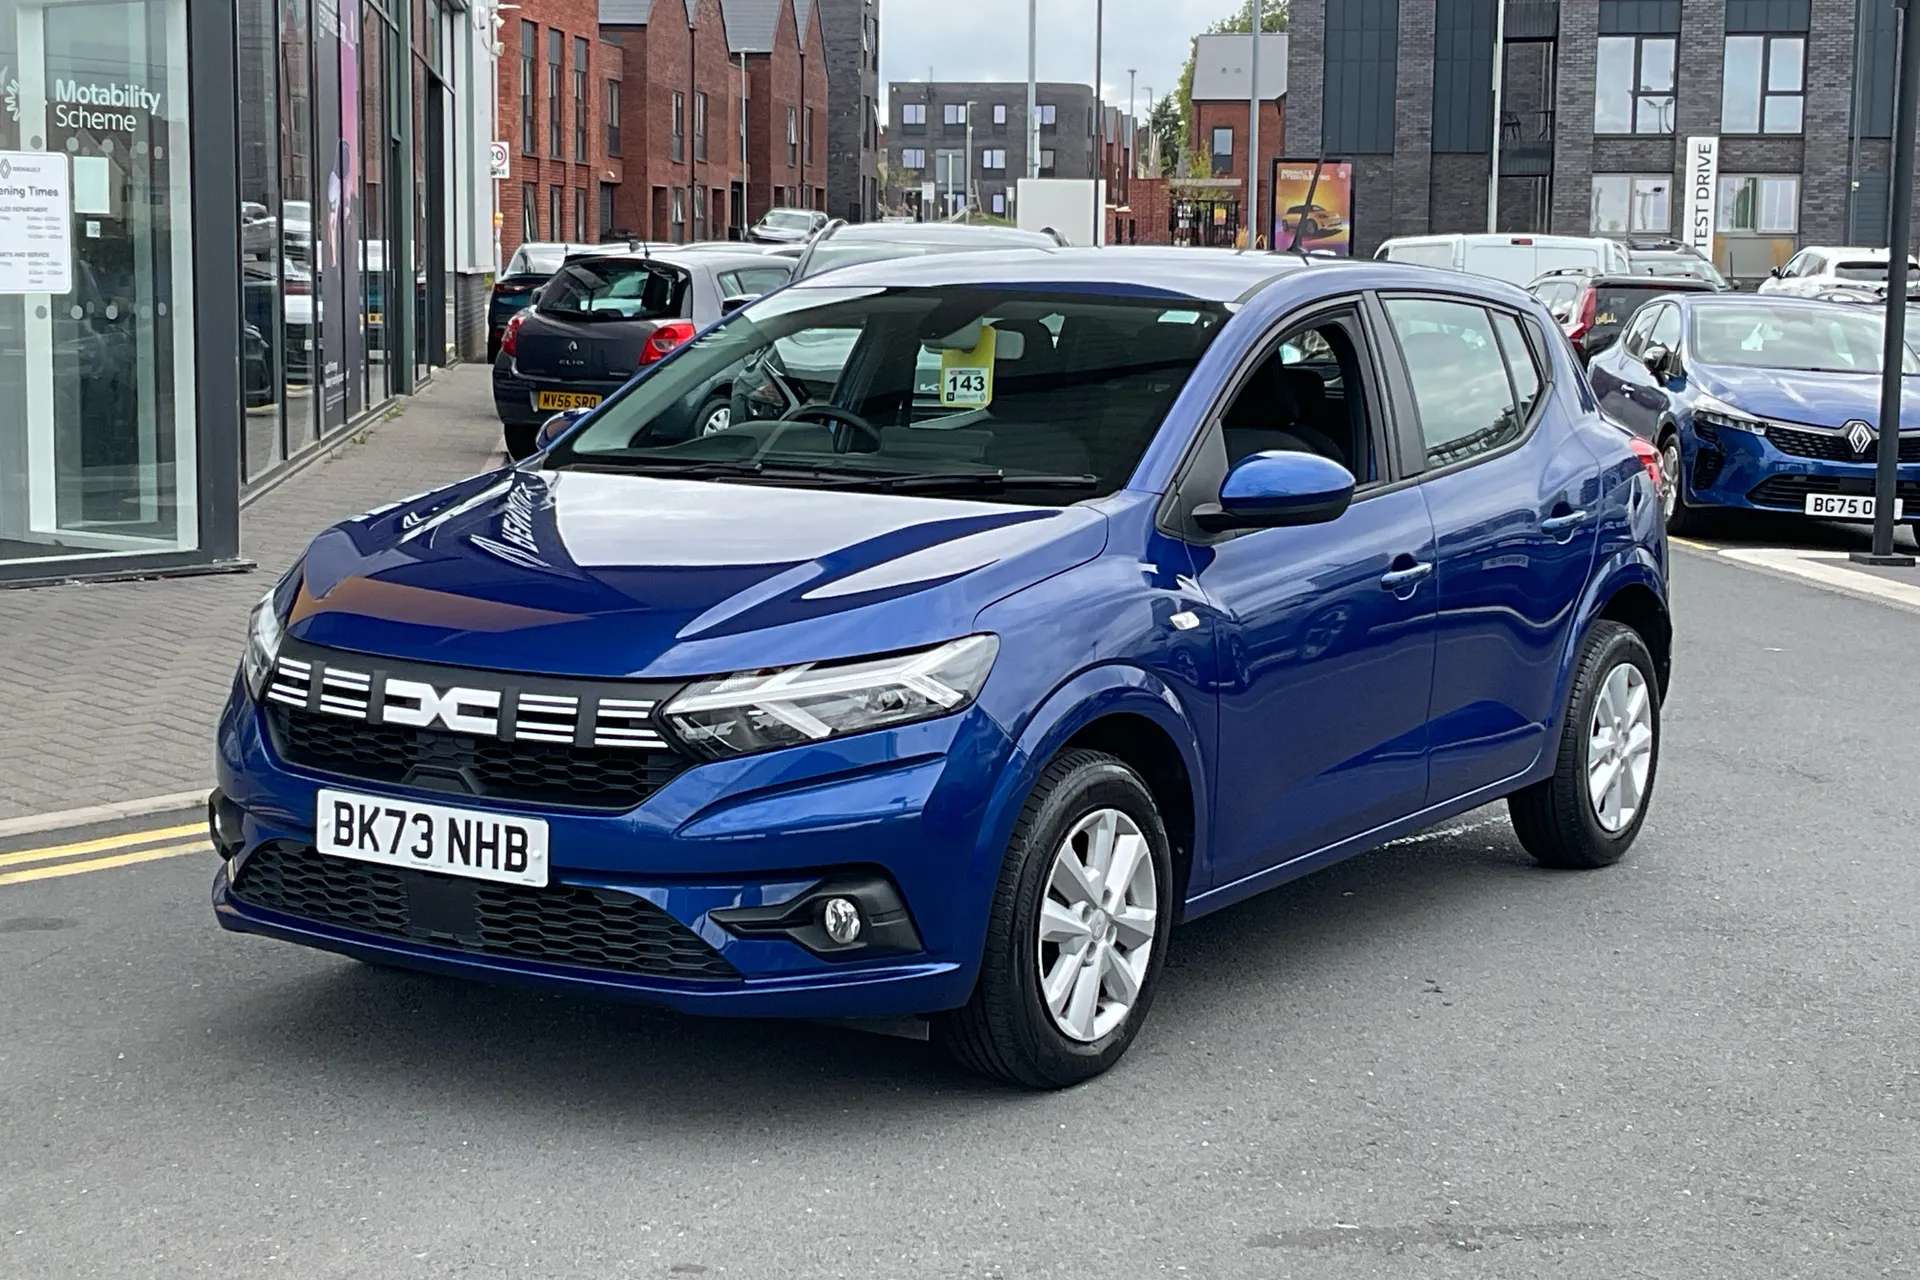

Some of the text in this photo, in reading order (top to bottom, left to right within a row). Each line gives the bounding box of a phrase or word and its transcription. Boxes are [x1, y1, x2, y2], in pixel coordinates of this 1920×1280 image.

[55, 78, 160, 115] Motability
[55, 104, 137, 132] Scheme
[28, 185, 59, 197] Times
[1694, 143, 1712, 248] TEST DRIVE
[949, 376, 985, 392] 143
[1813, 497, 1859, 514] BG75
[333, 800, 529, 874] BK73 NHB
